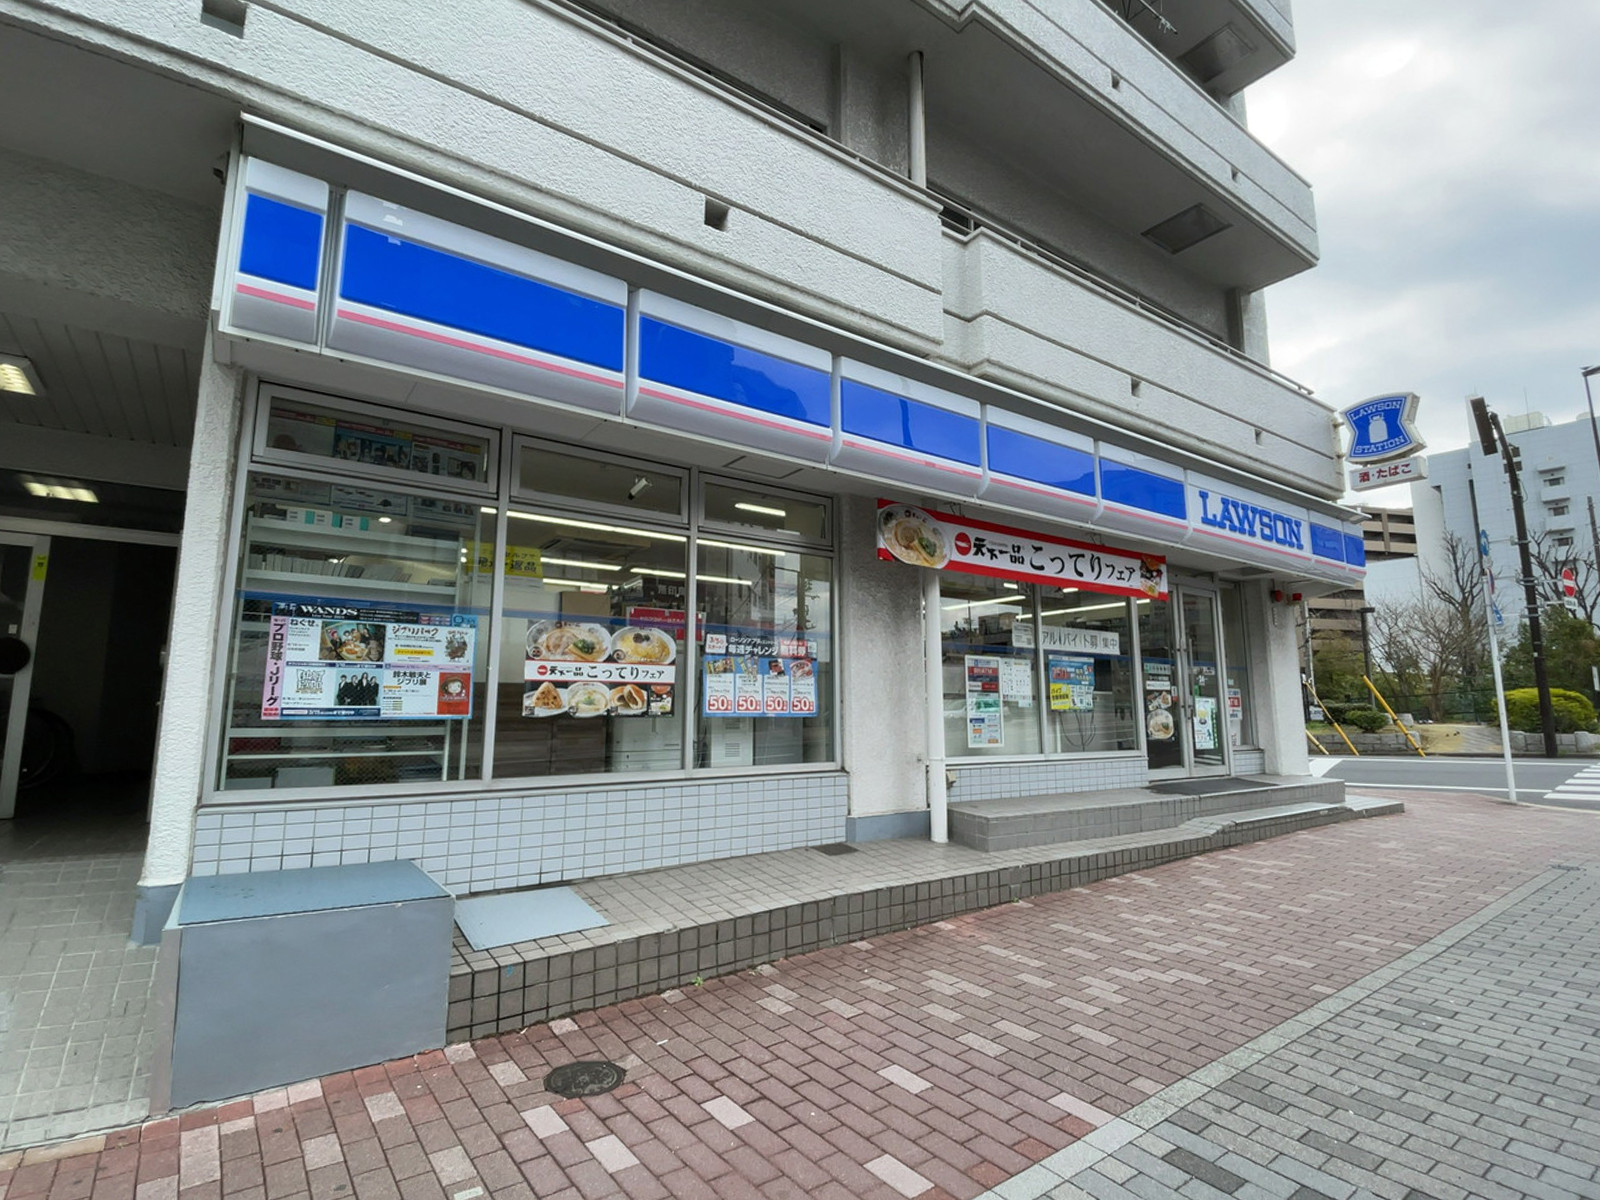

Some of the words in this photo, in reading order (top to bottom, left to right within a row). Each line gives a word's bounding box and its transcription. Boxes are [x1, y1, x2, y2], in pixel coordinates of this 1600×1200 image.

[1351, 401, 1401, 421] LAWSON
[1355, 435, 1404, 453] STATION
[1359, 463, 1412, 483] 酒・たばこ
[1199, 490, 1304, 550] LAWSON
[1029, 545, 1136, 582] こってりフェア
[300, 605, 358, 616] WANDS
